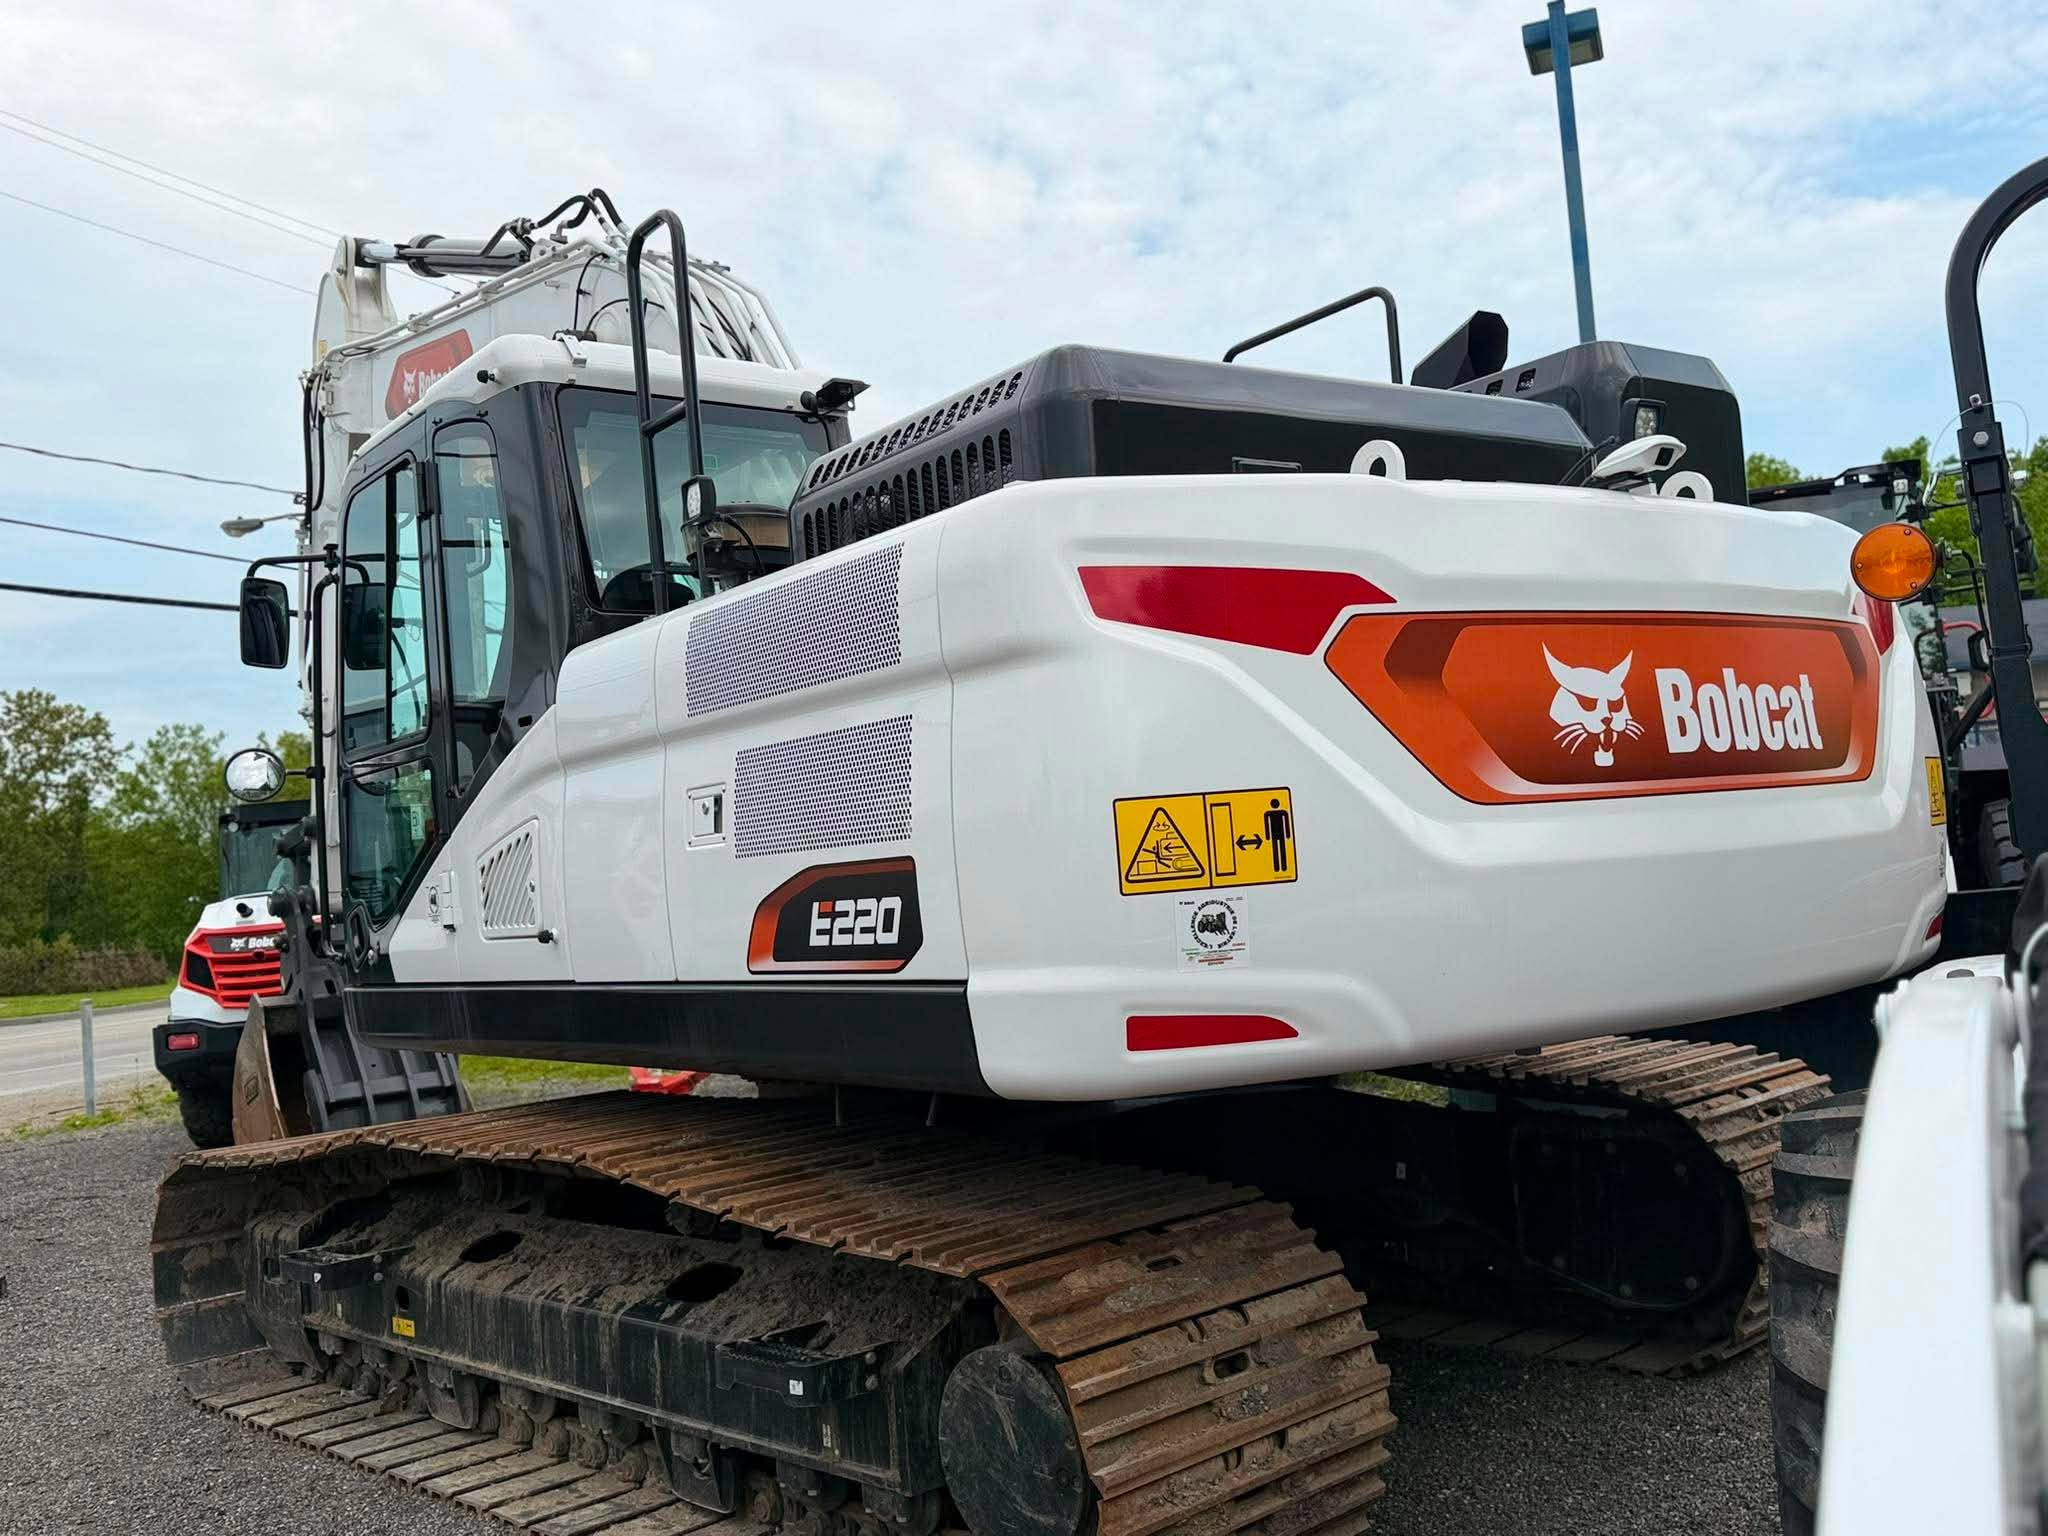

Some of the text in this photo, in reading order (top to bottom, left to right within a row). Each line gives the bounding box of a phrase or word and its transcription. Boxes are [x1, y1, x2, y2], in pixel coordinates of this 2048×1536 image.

[418, 366, 453, 400] Bob
[1654, 667, 1824, 753] Bobcat
[248, 936, 275, 949] Bobc
[809, 896, 902, 947] E220
